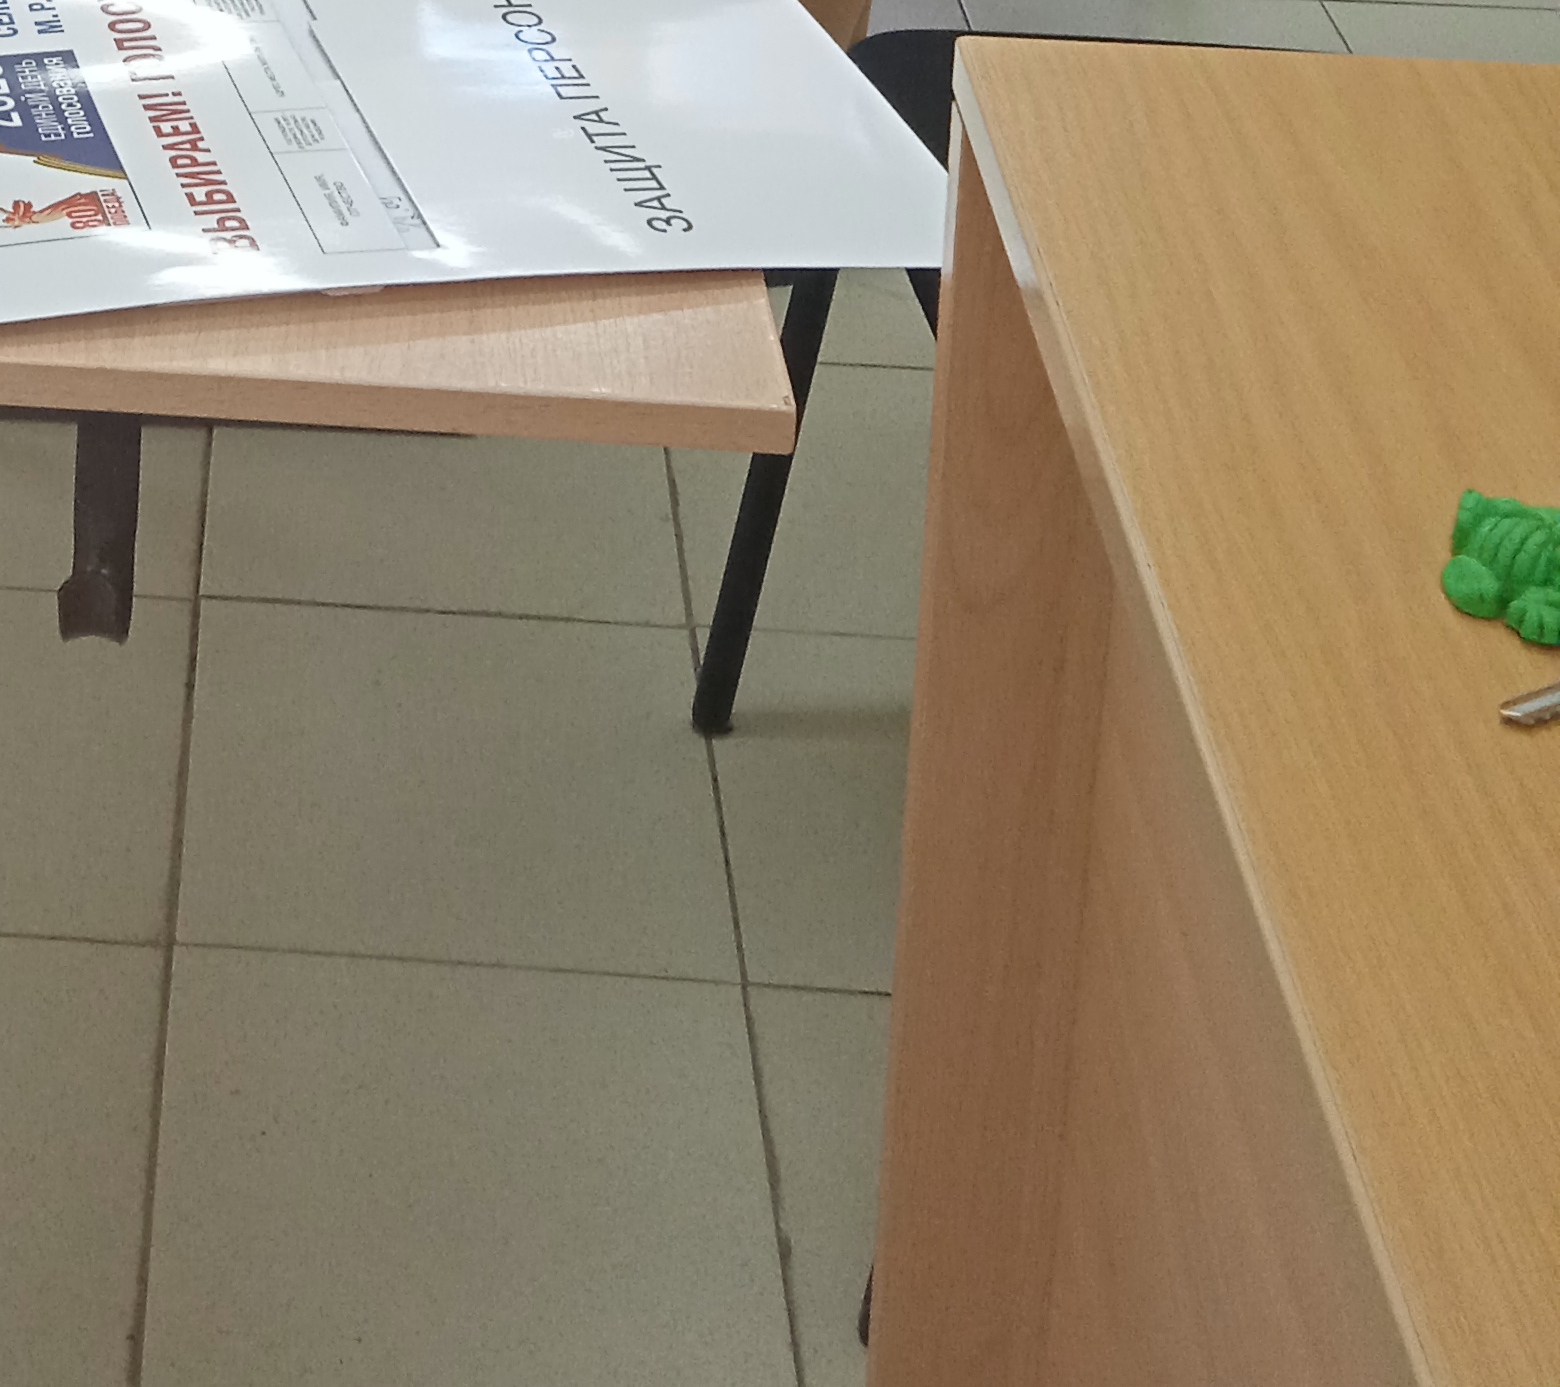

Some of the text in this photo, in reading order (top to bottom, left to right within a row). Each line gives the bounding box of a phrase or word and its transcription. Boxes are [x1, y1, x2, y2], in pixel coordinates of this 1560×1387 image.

[14, 59, 66, 141] ЕДИНЫЙ ДЕНЬ
[137, 91, 260, 254] ВЫБИРАЕМ!
[573, 107, 693, 233] ЗАЩИТА
